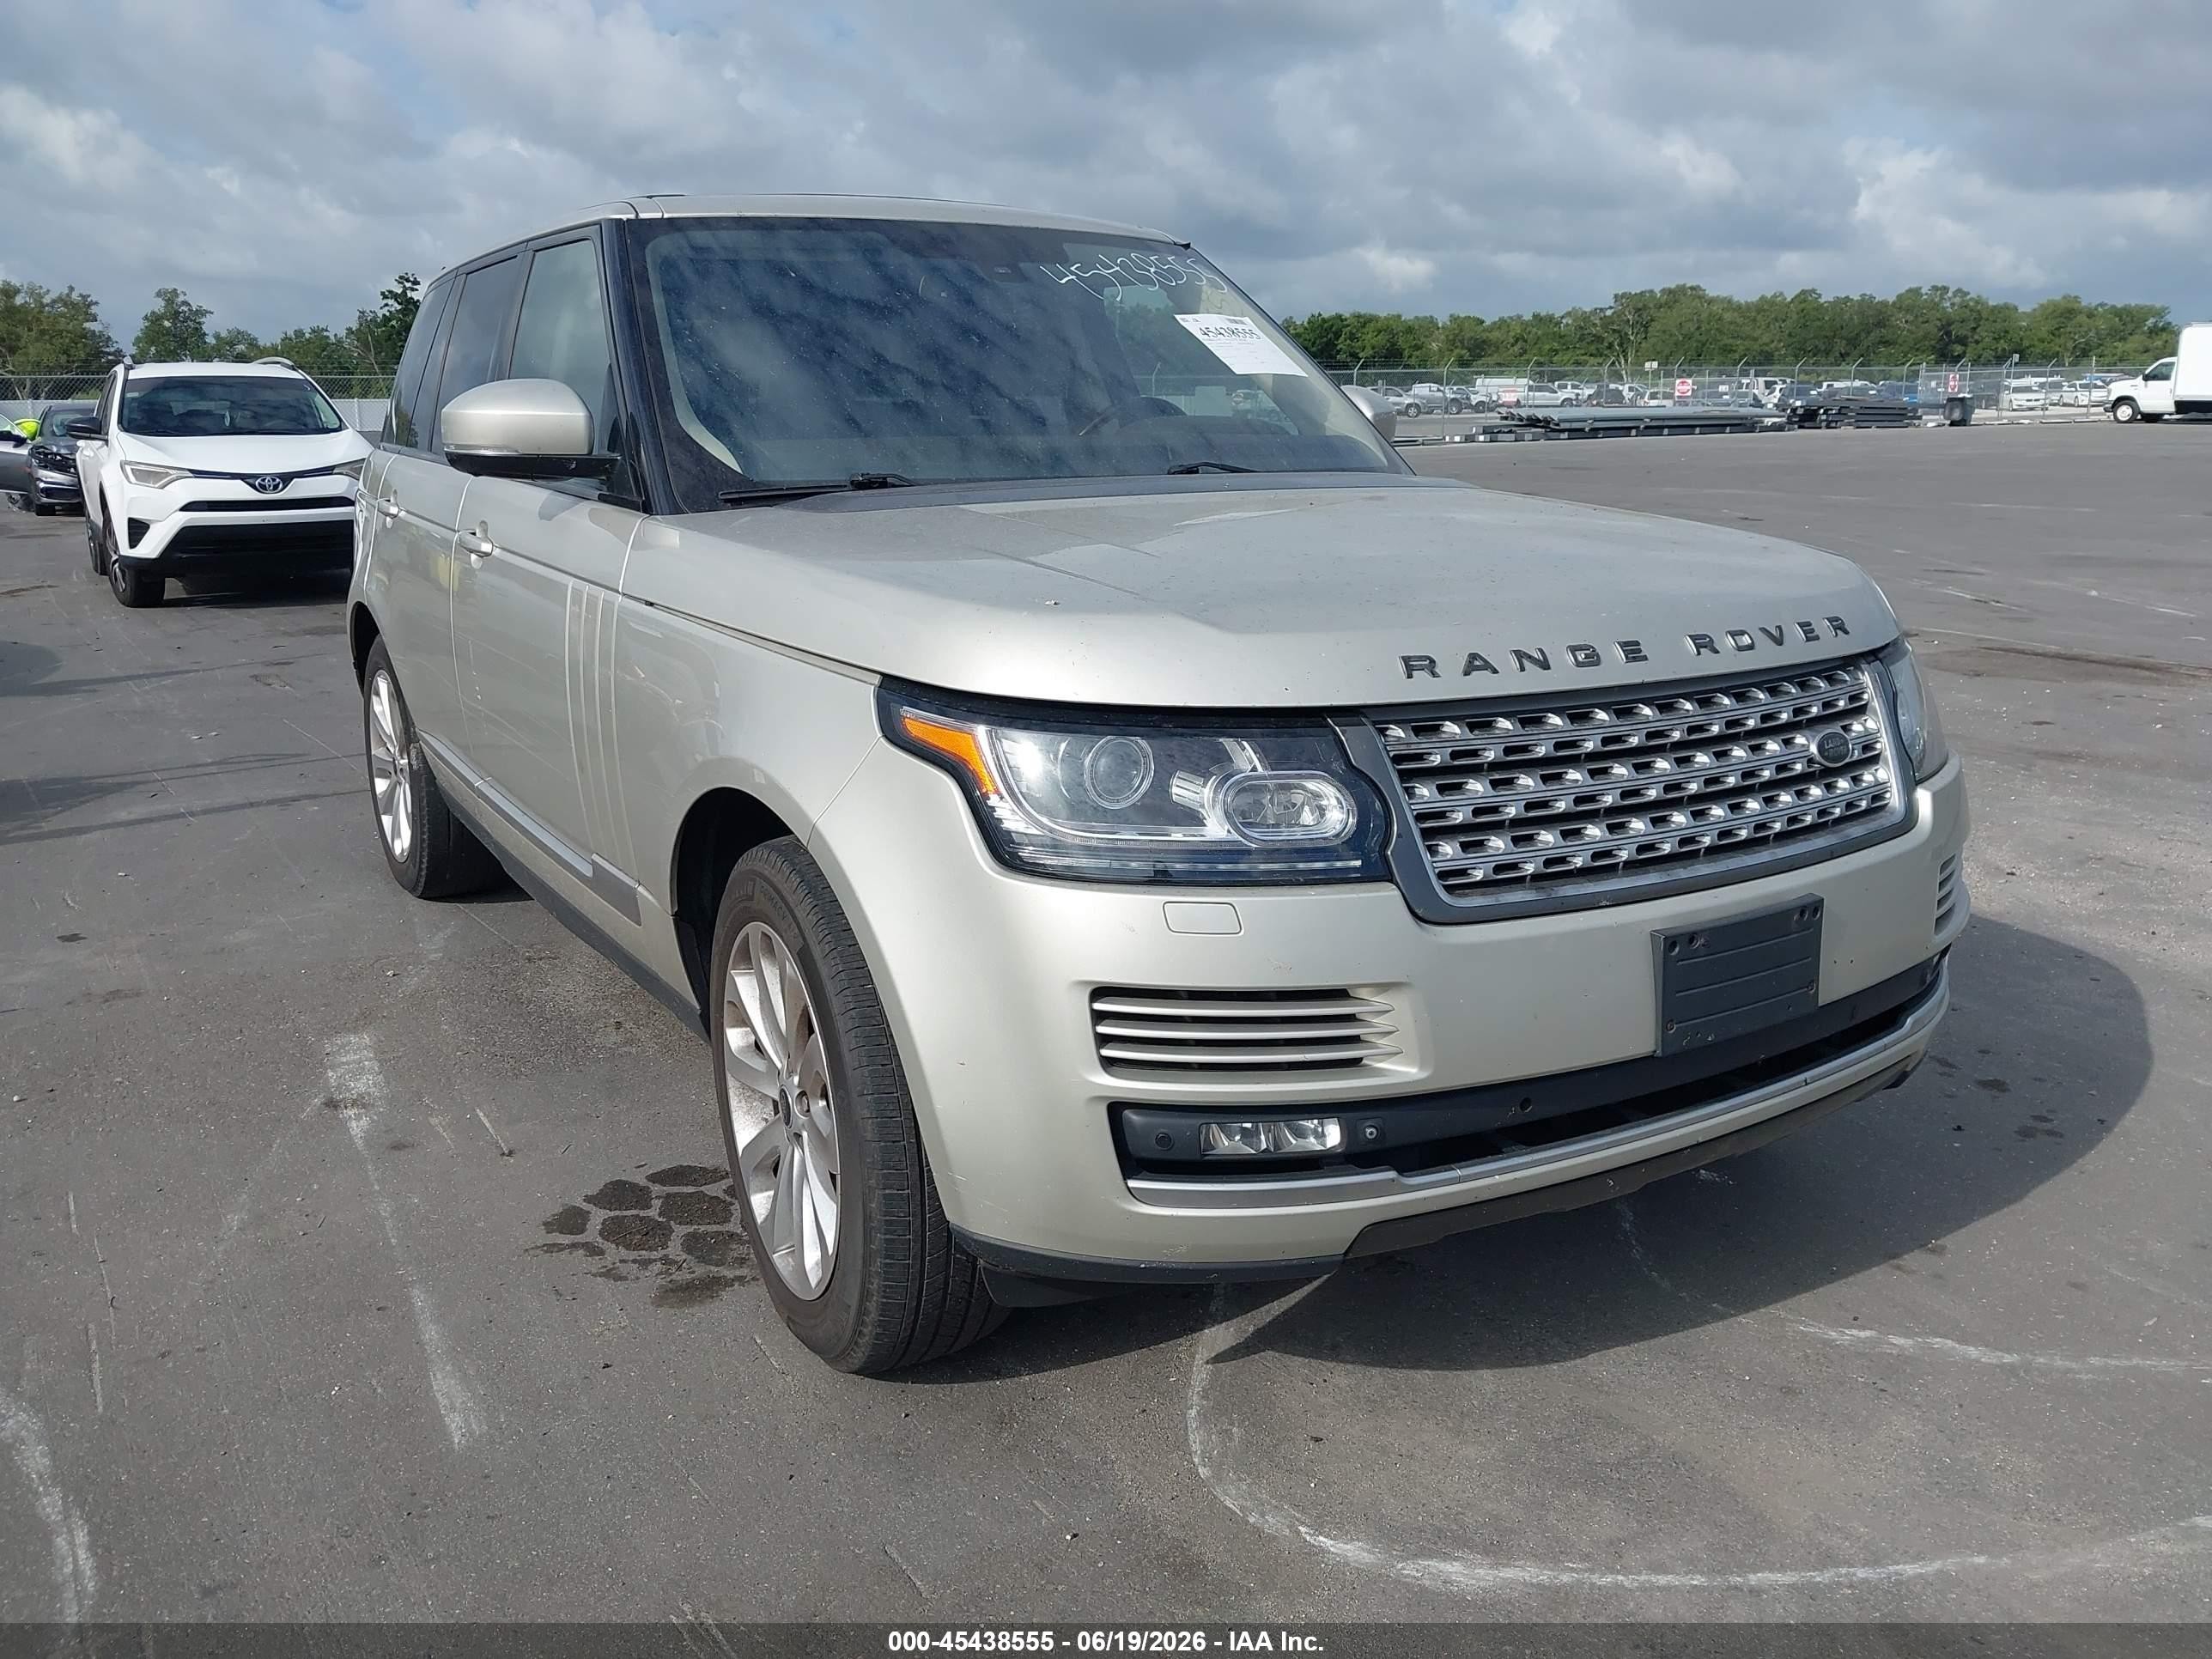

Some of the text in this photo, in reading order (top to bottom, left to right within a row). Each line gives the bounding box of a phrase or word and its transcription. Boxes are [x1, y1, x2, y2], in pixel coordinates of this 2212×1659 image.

[1038, 252, 1228, 301] 45438555
[1199, 326, 1261, 340] 45438555
[1398, 615, 1850, 680] RANGE ROVER
